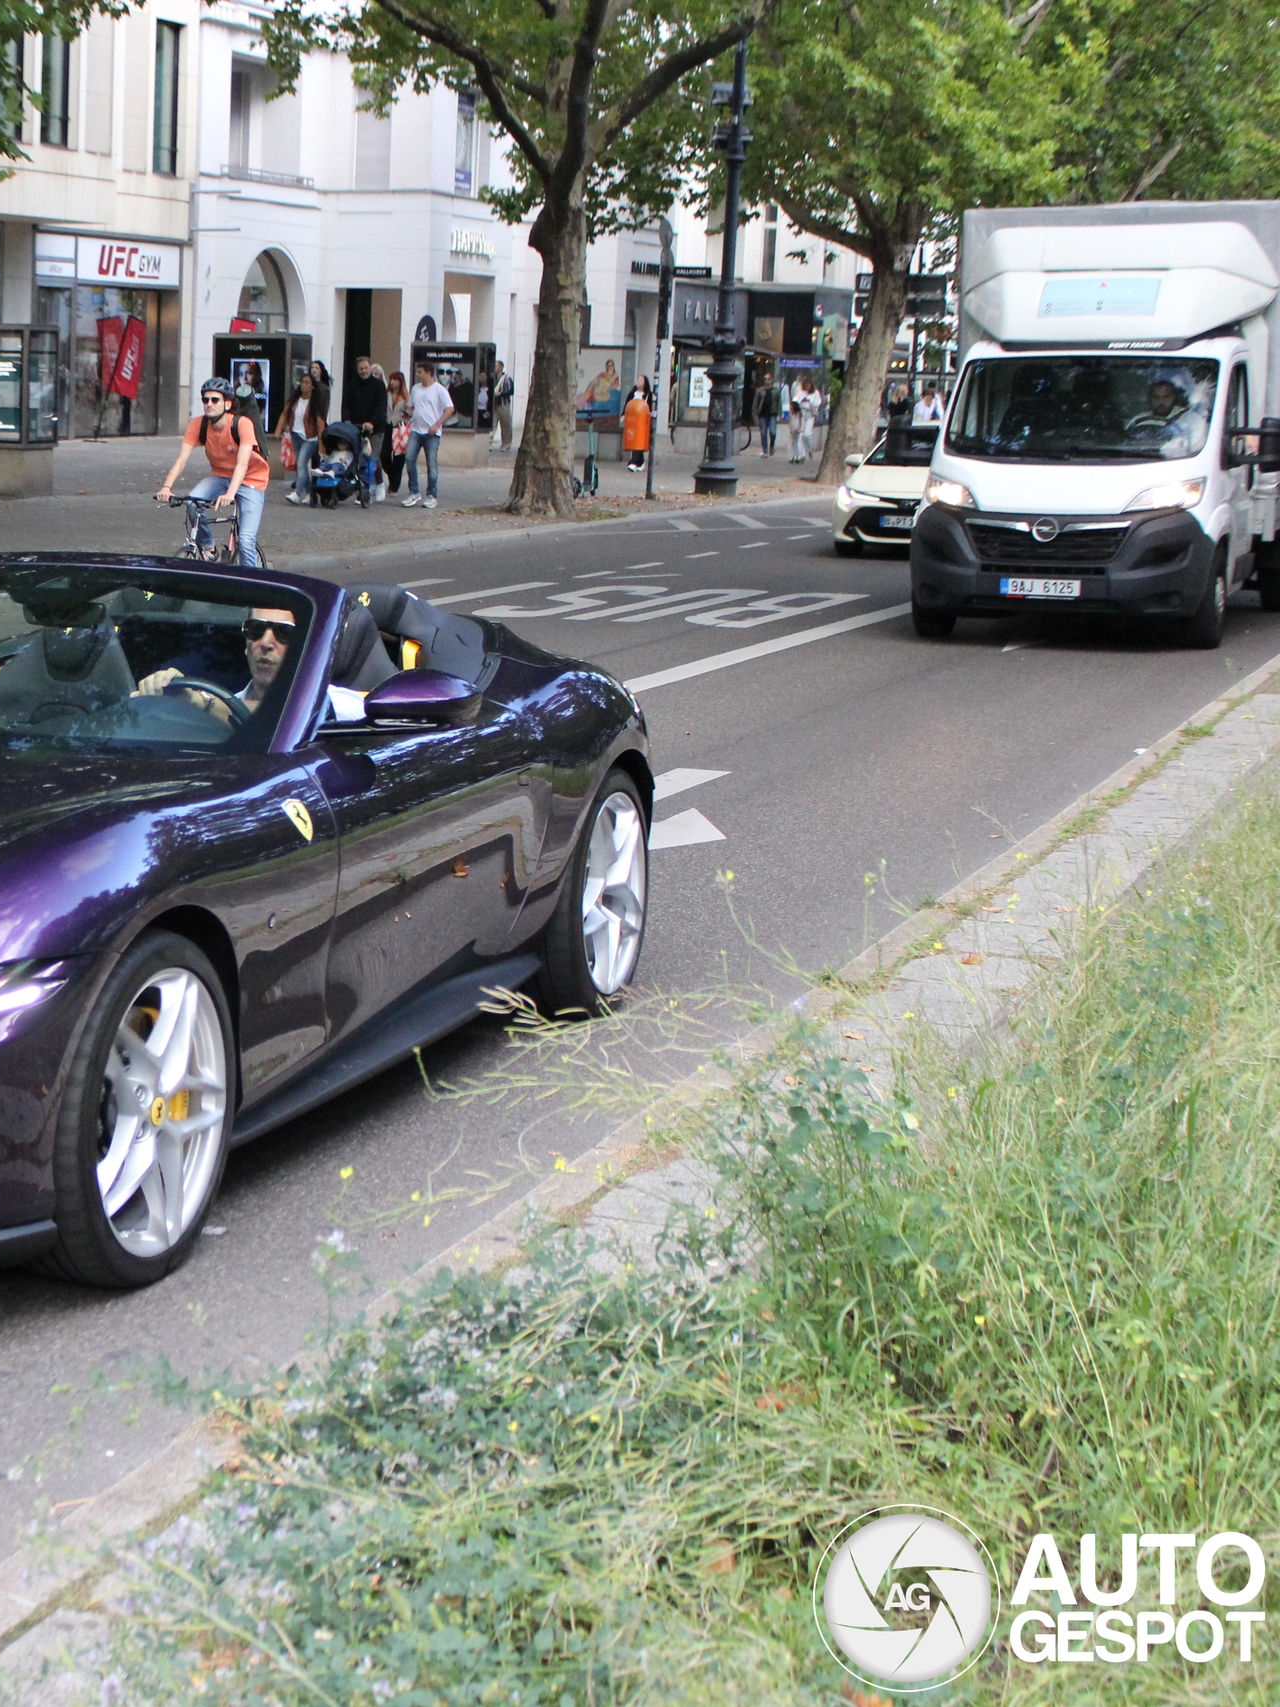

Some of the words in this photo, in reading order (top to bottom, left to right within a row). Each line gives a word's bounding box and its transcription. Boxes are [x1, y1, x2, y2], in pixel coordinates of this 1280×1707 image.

[98, 244, 139, 278] UFC
[138, 254, 162, 274] GYM
[121, 349, 137, 381] UFC
[1011, 580, 1034, 593] 9AJ
[1043, 581, 1074, 594] 6125
[471, 585, 870, 629] BUS
